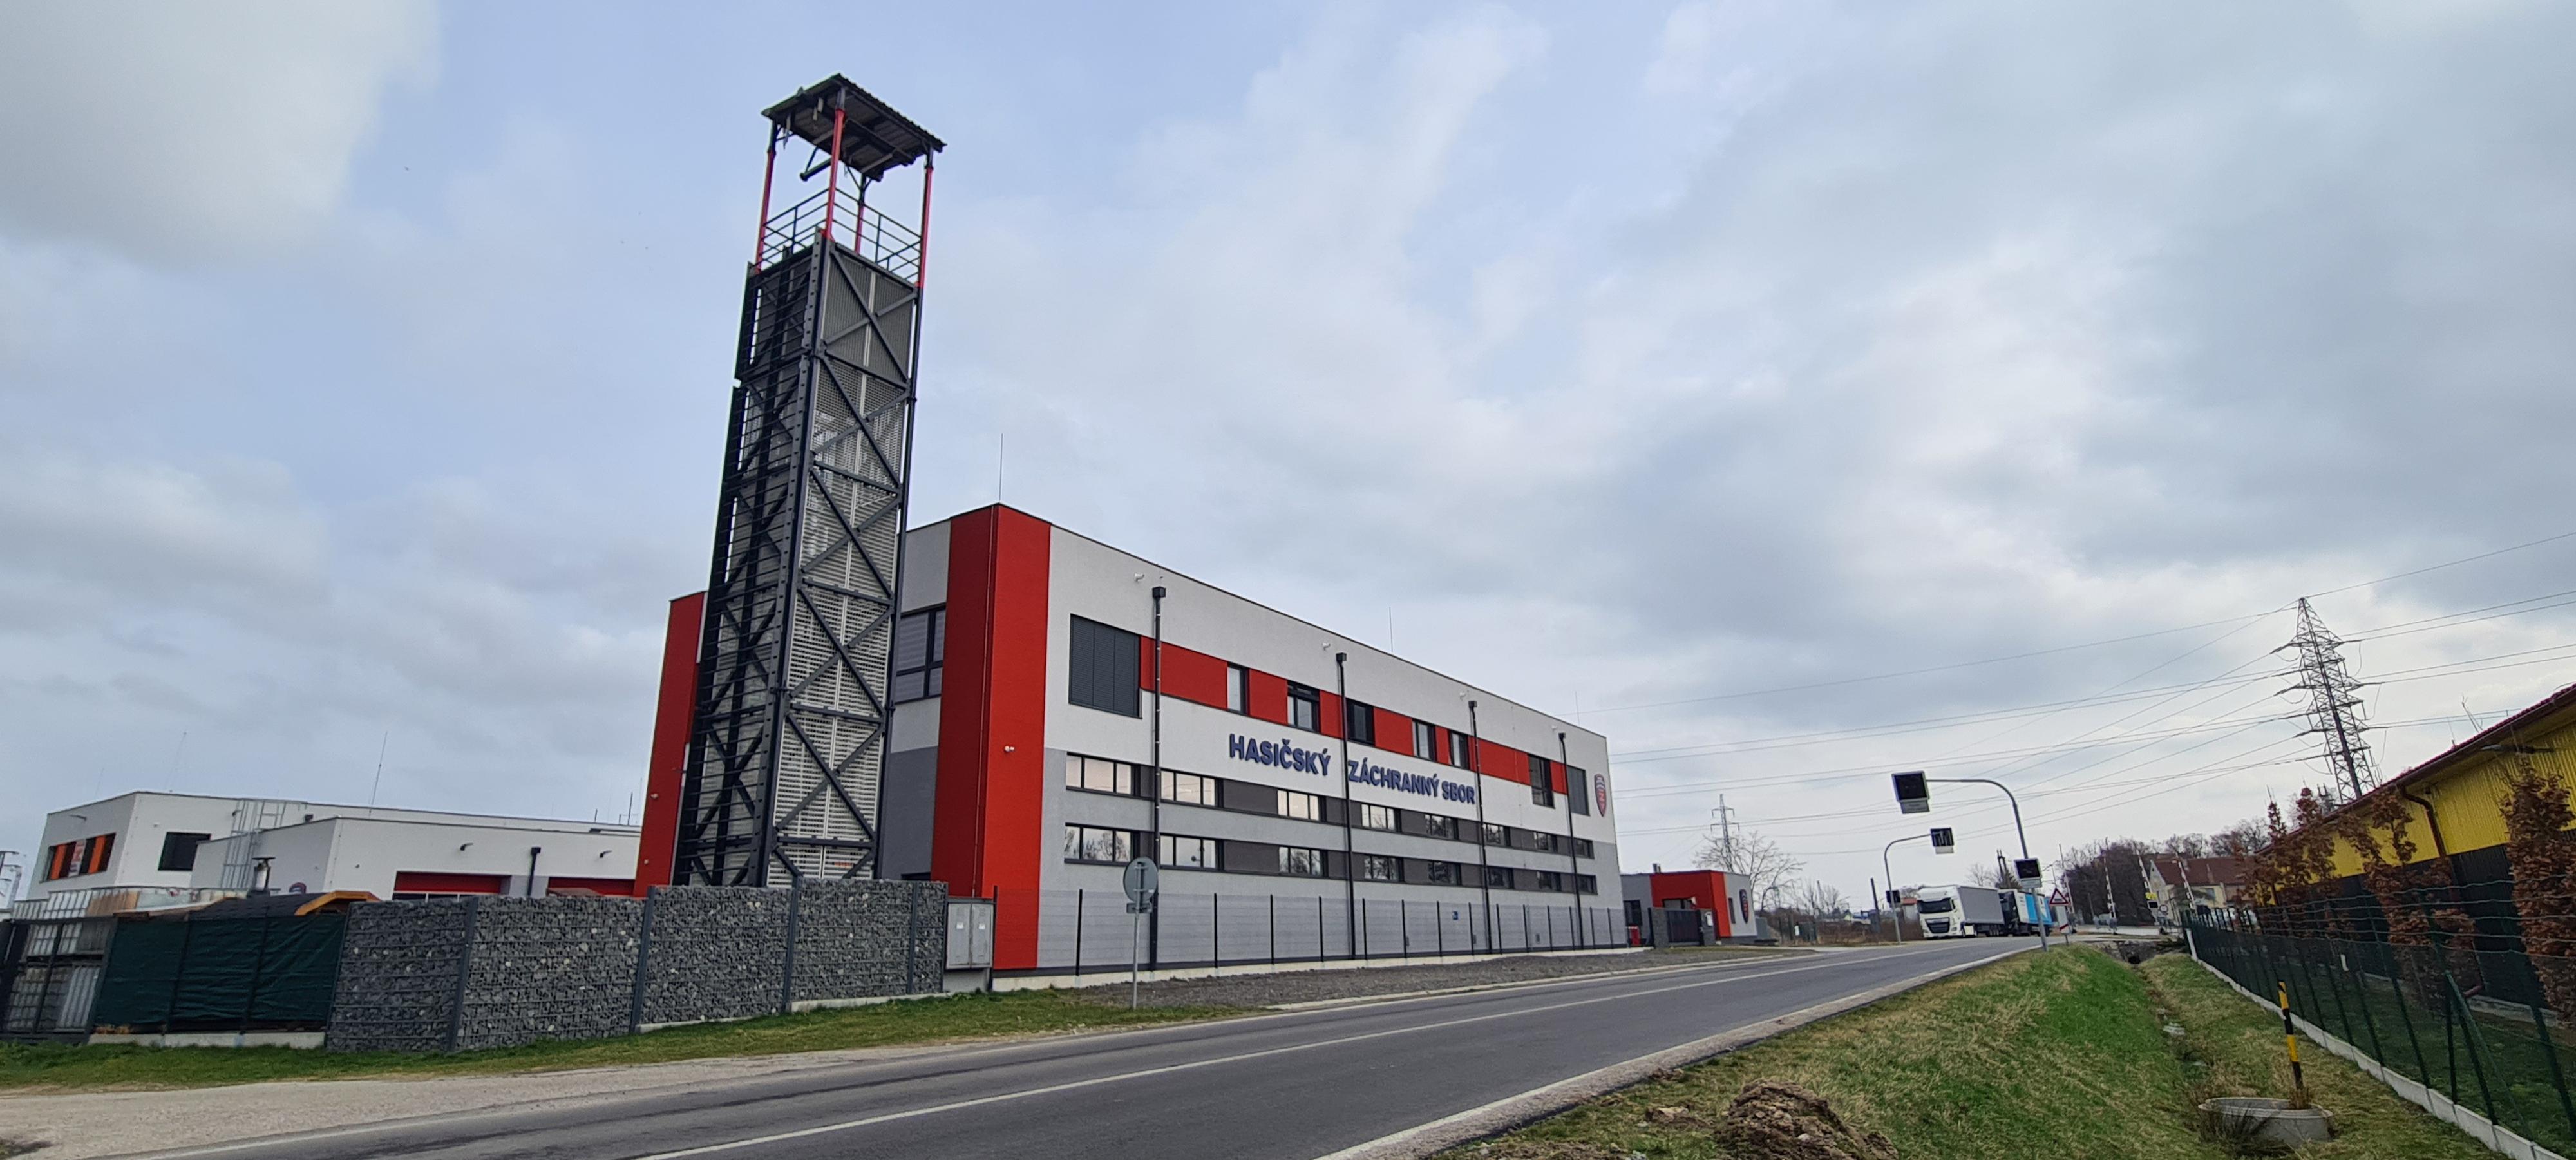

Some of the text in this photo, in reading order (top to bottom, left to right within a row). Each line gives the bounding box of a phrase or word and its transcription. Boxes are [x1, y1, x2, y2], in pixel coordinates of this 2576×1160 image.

[1229, 733, 1475, 804] HASIČSKÝ ZÁCHRANNÝ SBOR
